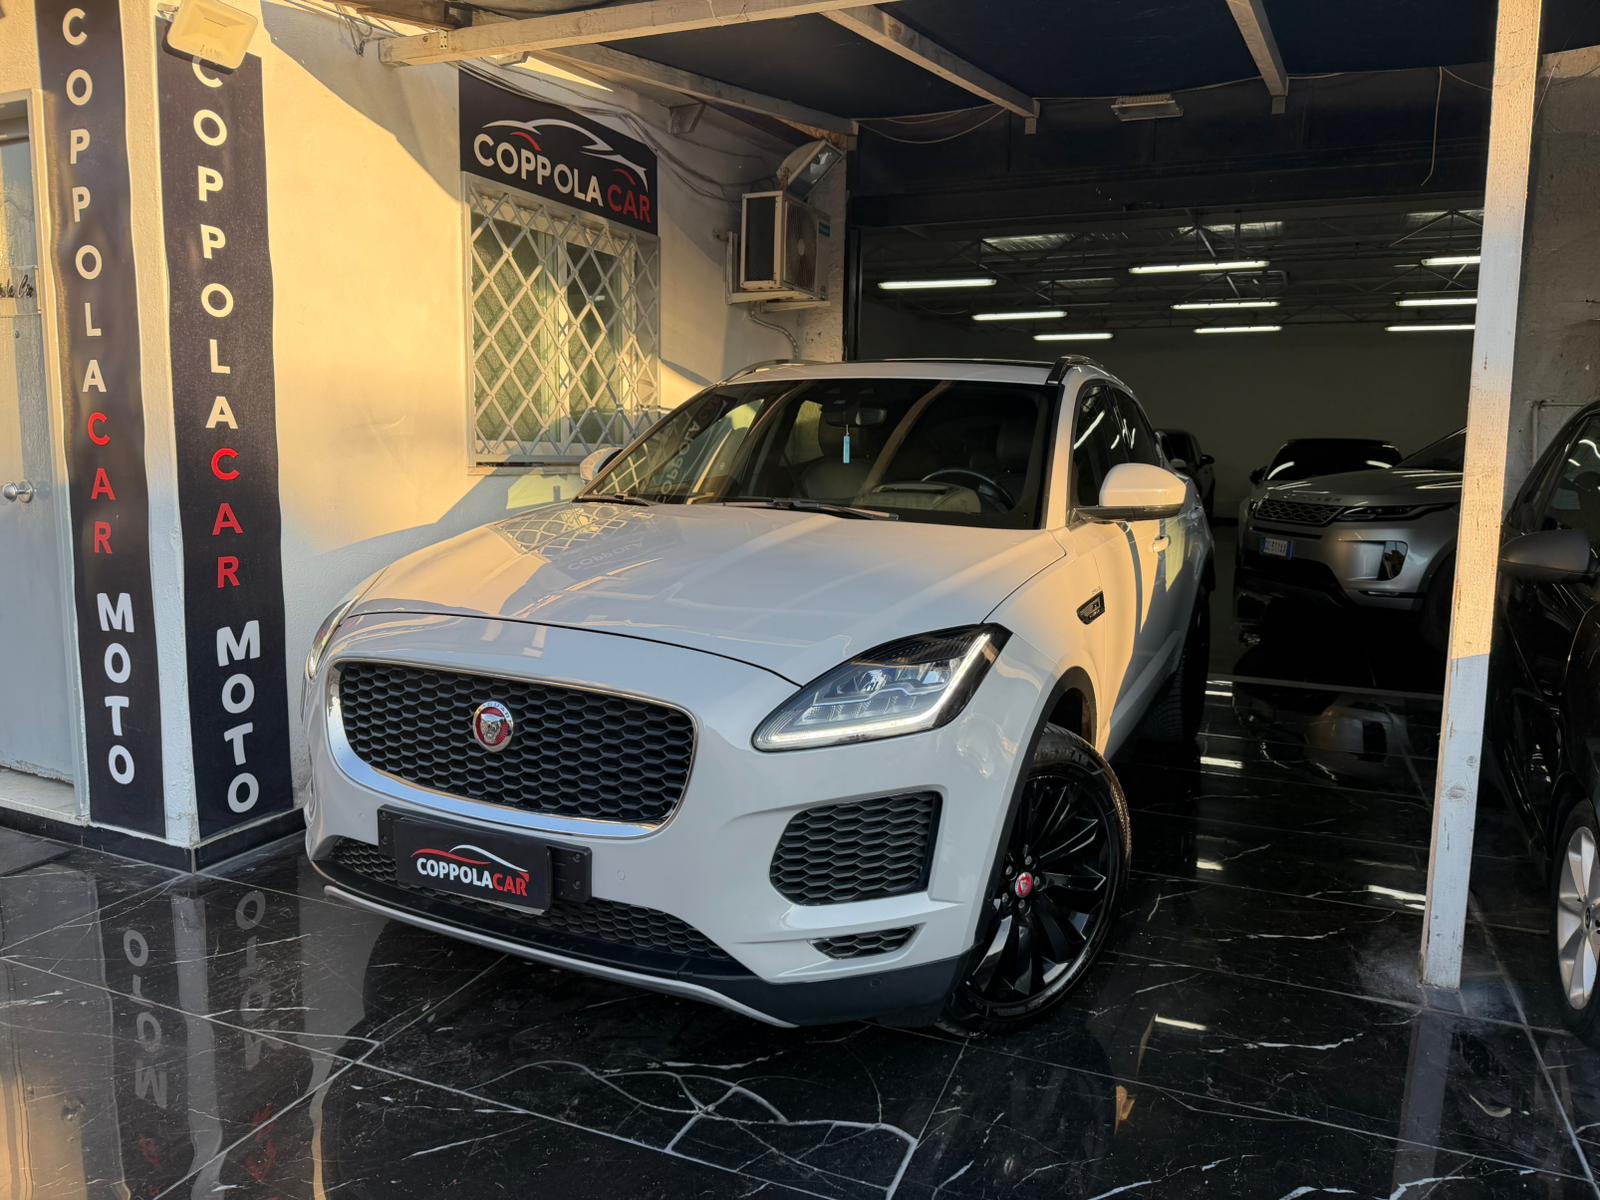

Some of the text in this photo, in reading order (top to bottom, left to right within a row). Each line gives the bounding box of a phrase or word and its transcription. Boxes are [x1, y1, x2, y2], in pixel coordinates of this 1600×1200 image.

[473, 133, 651, 224] COPPOLA CAR
[96, 592, 136, 786] MOTO
[216, 620, 261, 814] MOTO
